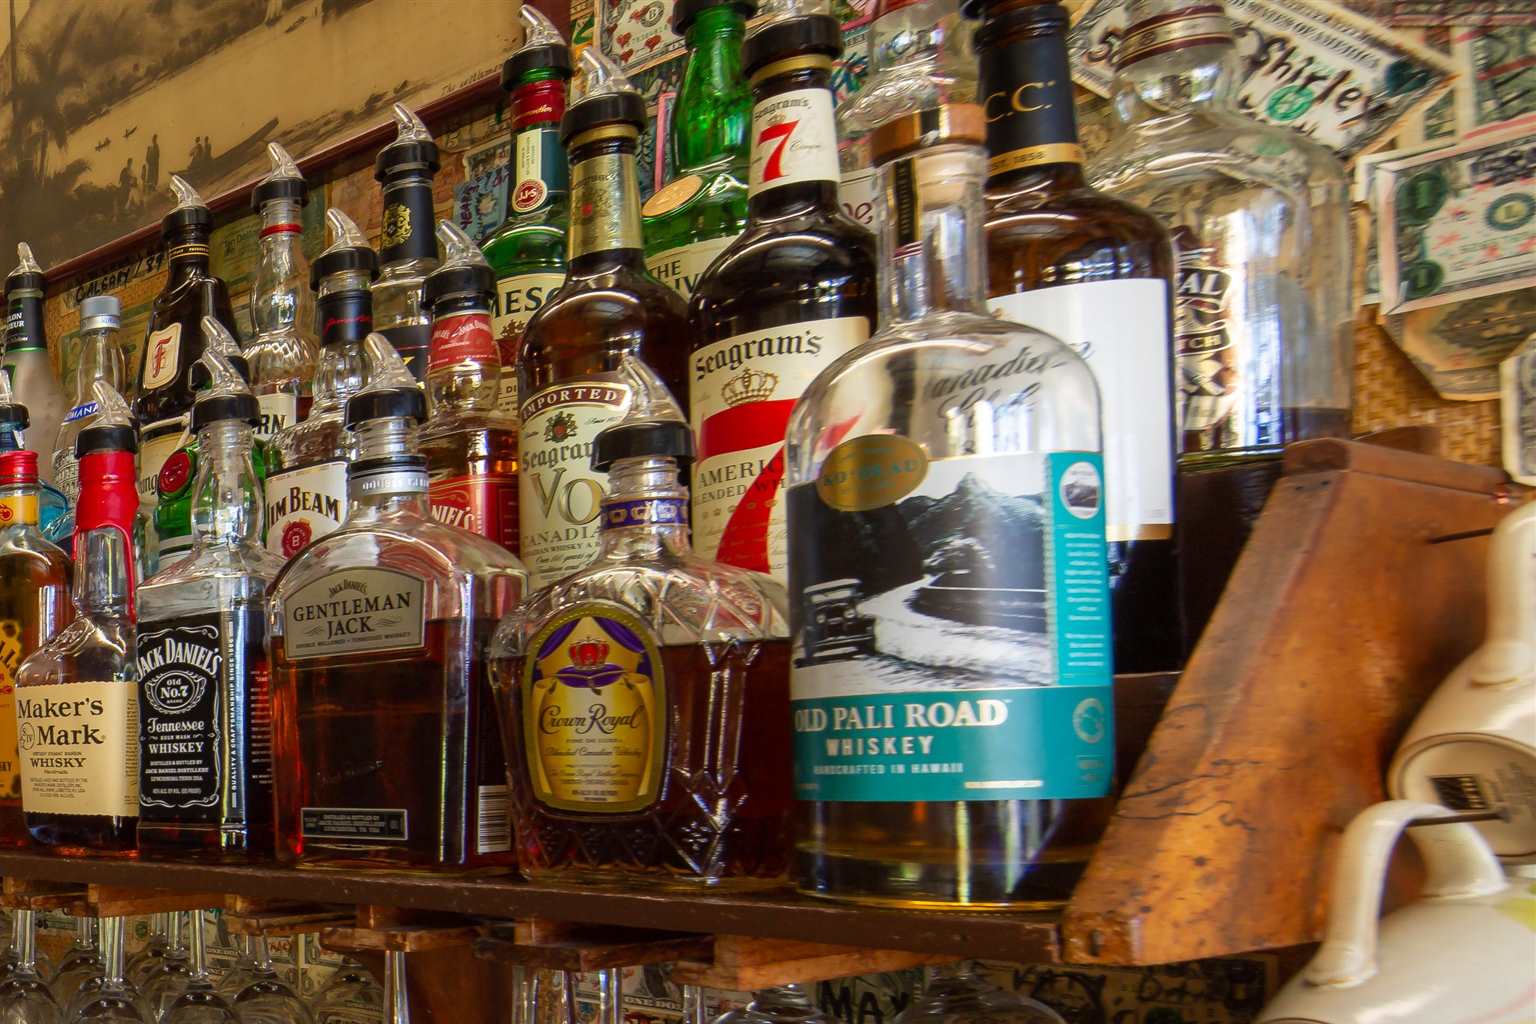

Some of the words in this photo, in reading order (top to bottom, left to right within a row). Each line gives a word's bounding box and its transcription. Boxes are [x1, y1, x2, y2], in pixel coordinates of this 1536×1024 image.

[758, 119, 801, 183] 7
[650, 259, 681, 278] THE
[695, 329, 824, 381] Seagram's
[522, 388, 617, 419] IMPORTED
[289, 486, 340, 525] BEAM
[529, 467, 607, 526] VO
[293, 592, 412, 623] GENTLEMAN
[327, 616, 375, 640] JACK
[136, 645, 163, 682] JACK
[164, 637, 223, 676] DANIEL'S
[160, 685, 189, 699] No.7
[166, 678, 182, 686] Old
[17, 697, 105, 719] Maker's
[540, 704, 588, 735] Crown
[576, 703, 645, 735] Royal
[794, 708, 828, 734] OLD
[833, 704, 894, 731] PALI
[903, 699, 1009, 728] ROAD
[36, 723, 105, 746] Mark
[147, 717, 205, 734] Tennessee
[148, 741, 205, 755] WHISKEY
[825, 735, 934, 757] WHISKEY
[30, 757, 87, 768] WHISKY
[890, 764, 905, 775] IN
